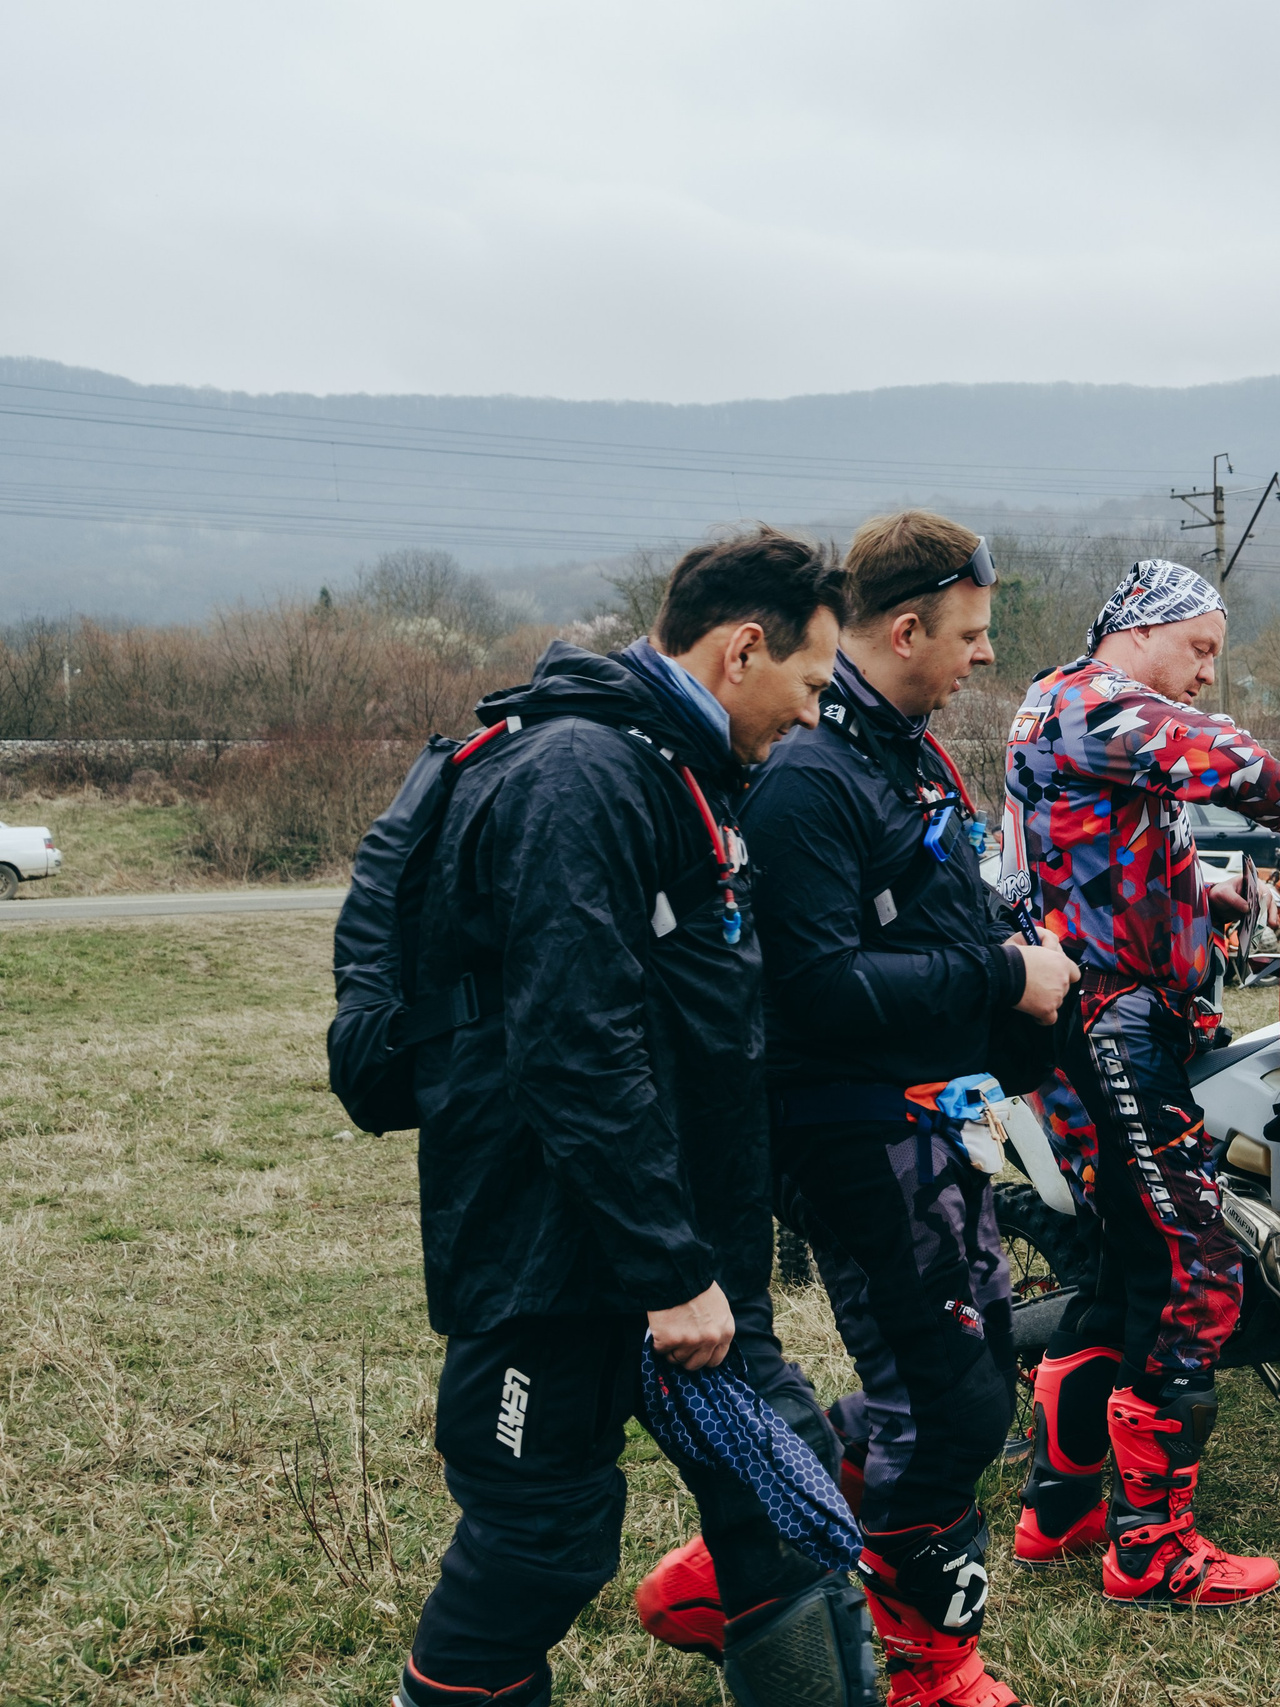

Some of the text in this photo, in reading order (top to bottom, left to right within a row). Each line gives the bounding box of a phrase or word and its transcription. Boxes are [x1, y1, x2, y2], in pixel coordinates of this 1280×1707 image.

[1145, 593, 1182, 619] ENDURO
[1098, 1038, 1131, 1090] ГАЗ
[496, 1367, 531, 1459] LEATT
[943, 1553, 968, 1572] LEATT
